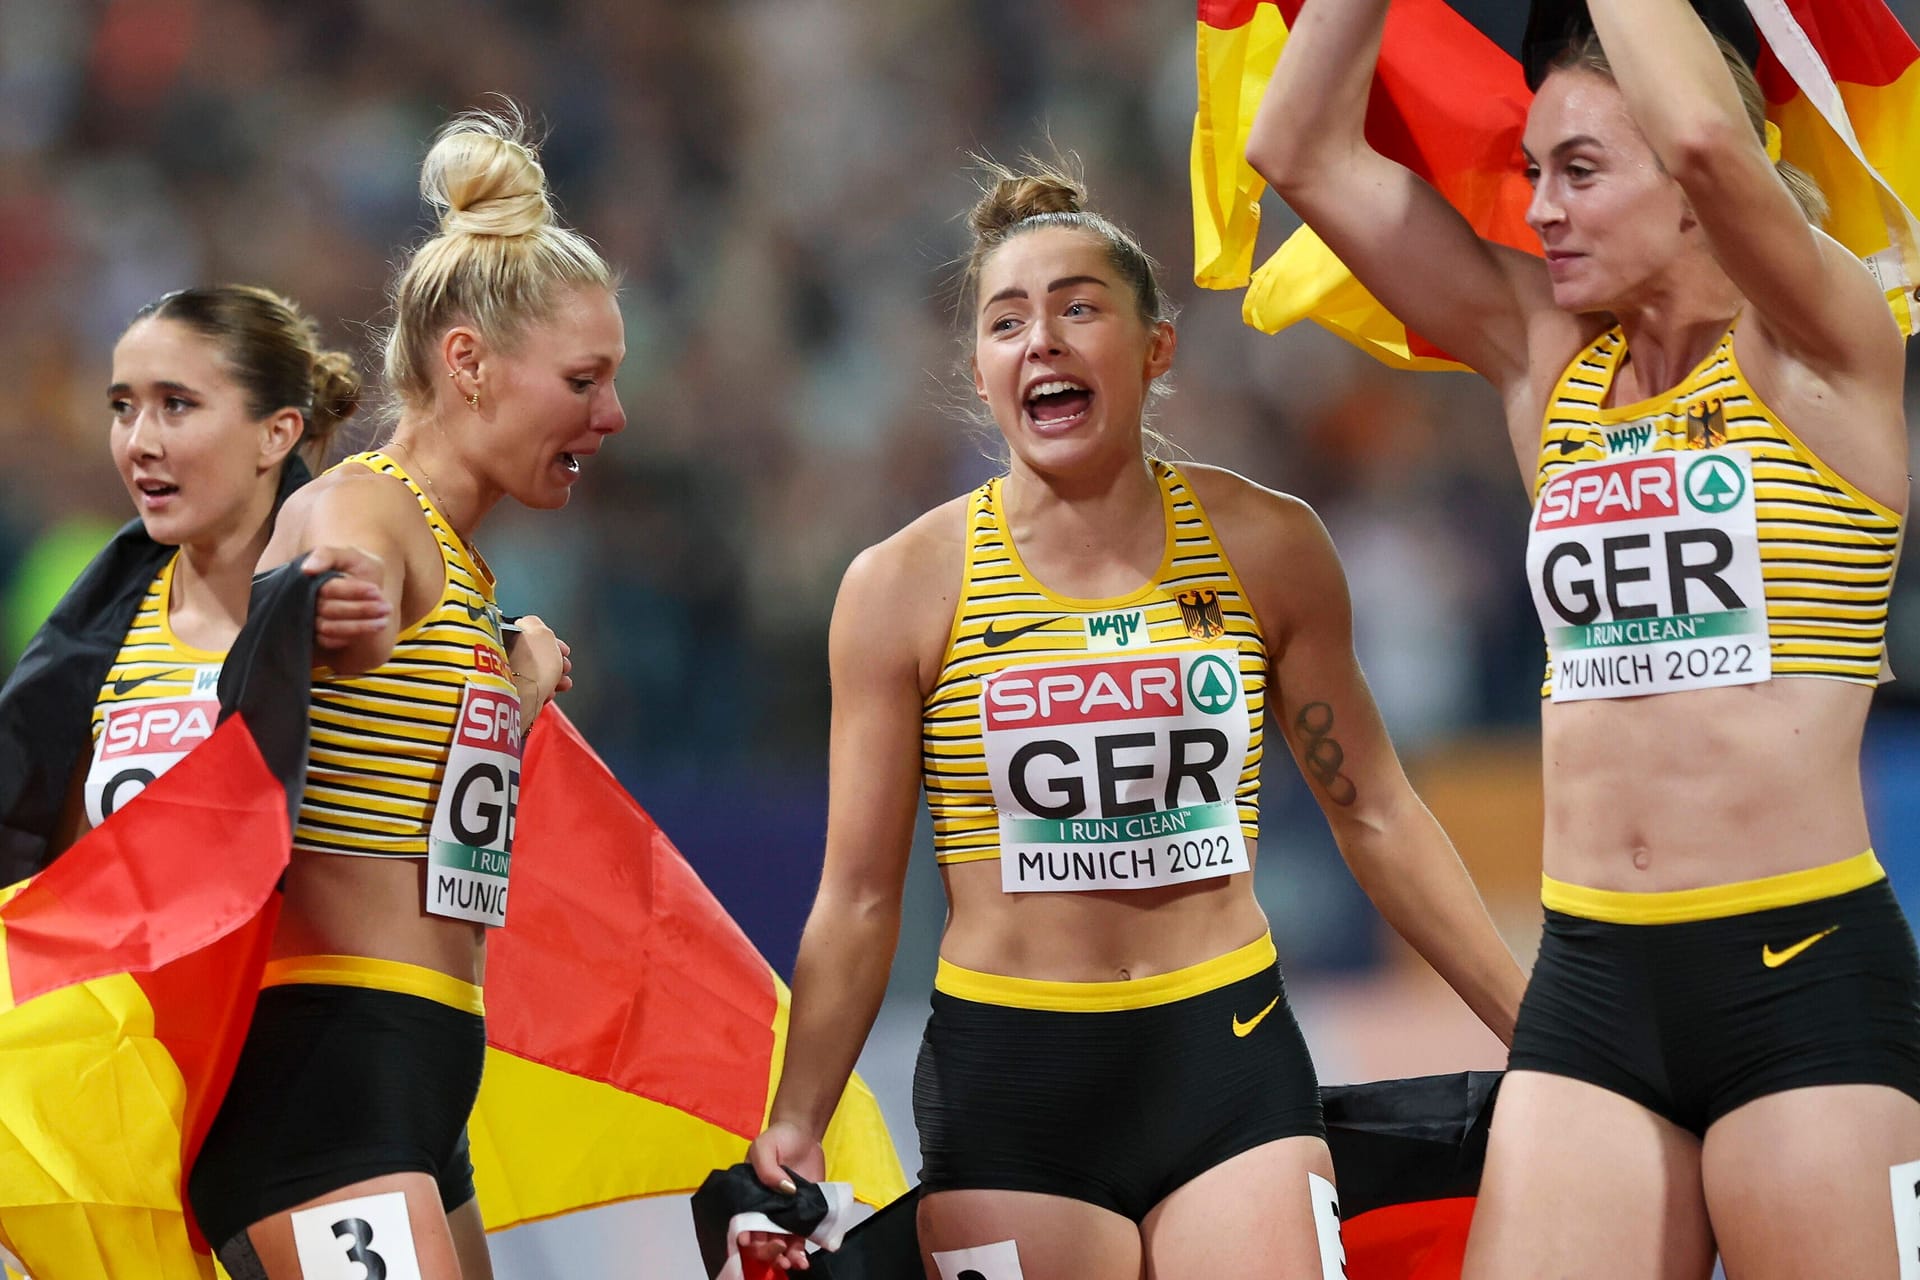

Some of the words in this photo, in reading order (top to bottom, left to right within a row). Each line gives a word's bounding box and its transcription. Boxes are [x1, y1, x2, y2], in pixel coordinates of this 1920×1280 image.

[1540, 467, 1674, 523] SPAR
[1542, 528, 1748, 626] GER
[1586, 628, 1591, 645] I
[1594, 625, 1623, 645] RUN
[1560, 654, 1654, 690] MUNICH
[1665, 644, 1753, 680] 2022
[990, 667, 1178, 722] SPAR
[1008, 728, 1229, 820] GER
[1060, 822, 1065, 839] I
[1072, 822, 1118, 840] RUN
[471, 850, 477, 867] I
[481, 852, 510, 873] RUN
[1019, 848, 1155, 881] MUNICH
[1167, 835, 1233, 873] 2022
[331, 1218, 387, 1280] 3
